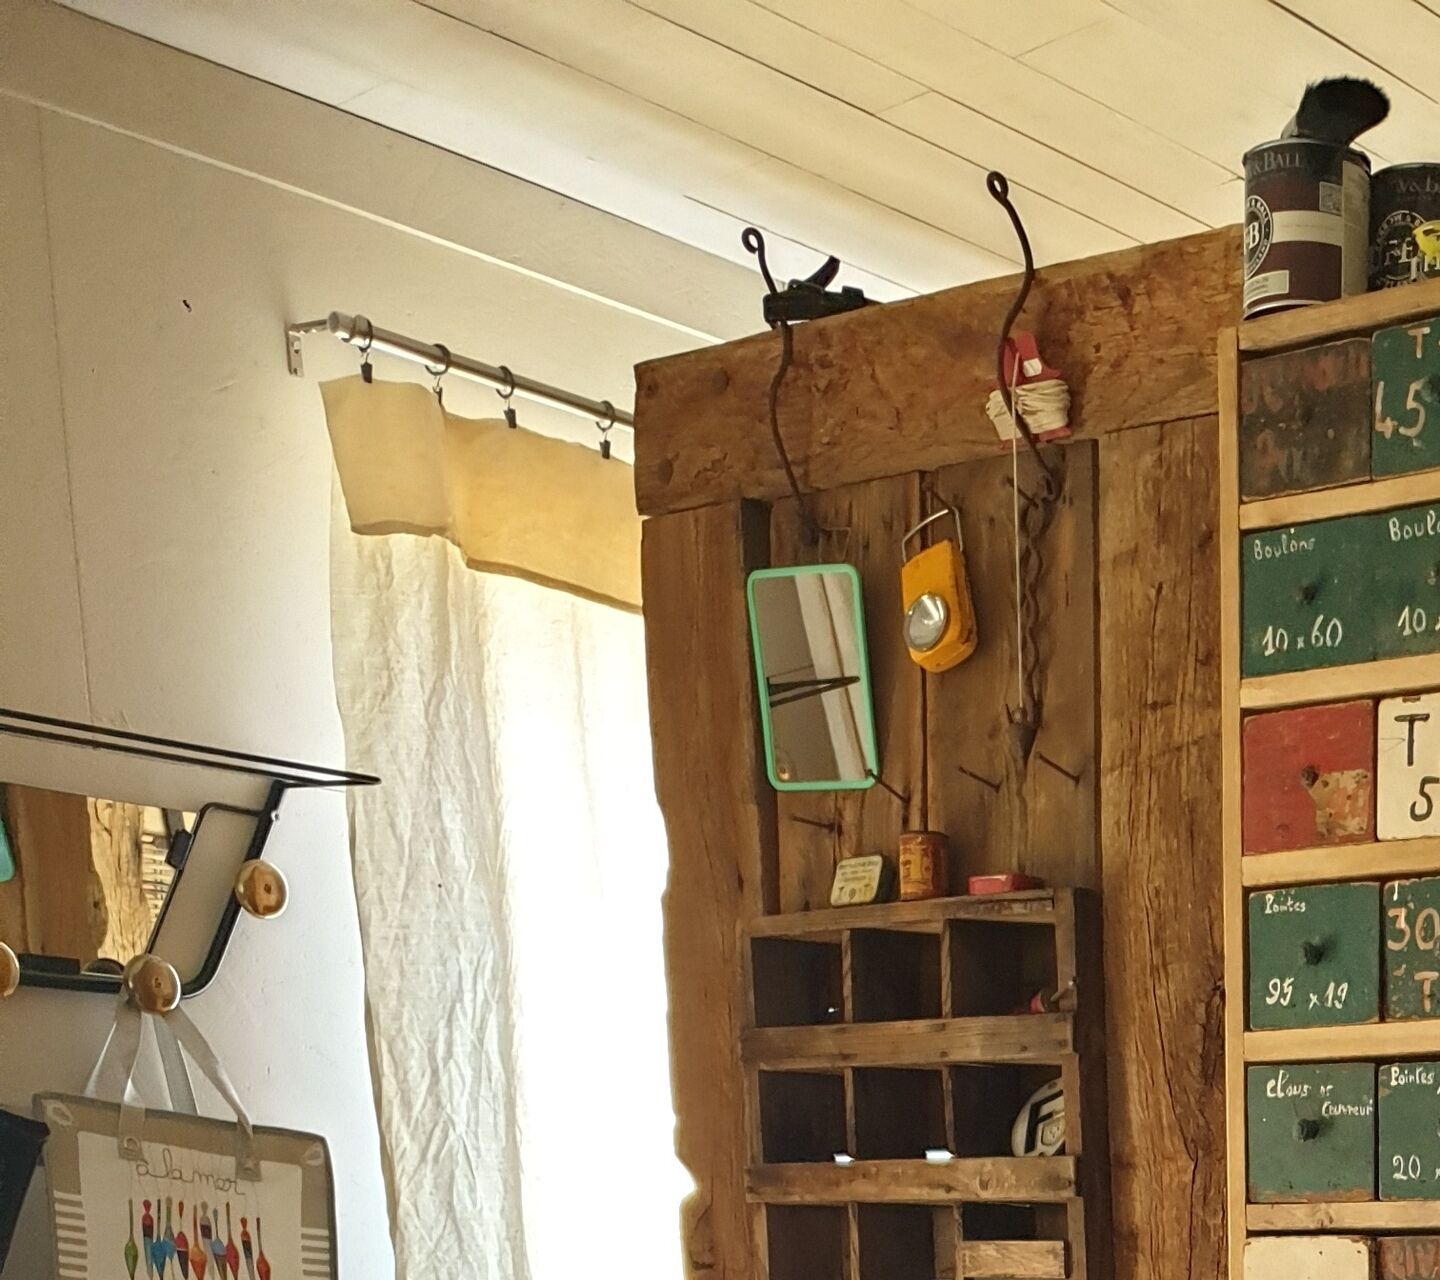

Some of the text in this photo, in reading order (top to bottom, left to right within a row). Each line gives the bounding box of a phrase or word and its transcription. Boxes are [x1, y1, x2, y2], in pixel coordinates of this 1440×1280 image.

[1253, 532, 1317, 561] Boulons
[1397, 605, 1427, 637] 10
[1394, 712, 1431, 767] T
[1393, 1154, 1421, 1180] 20
